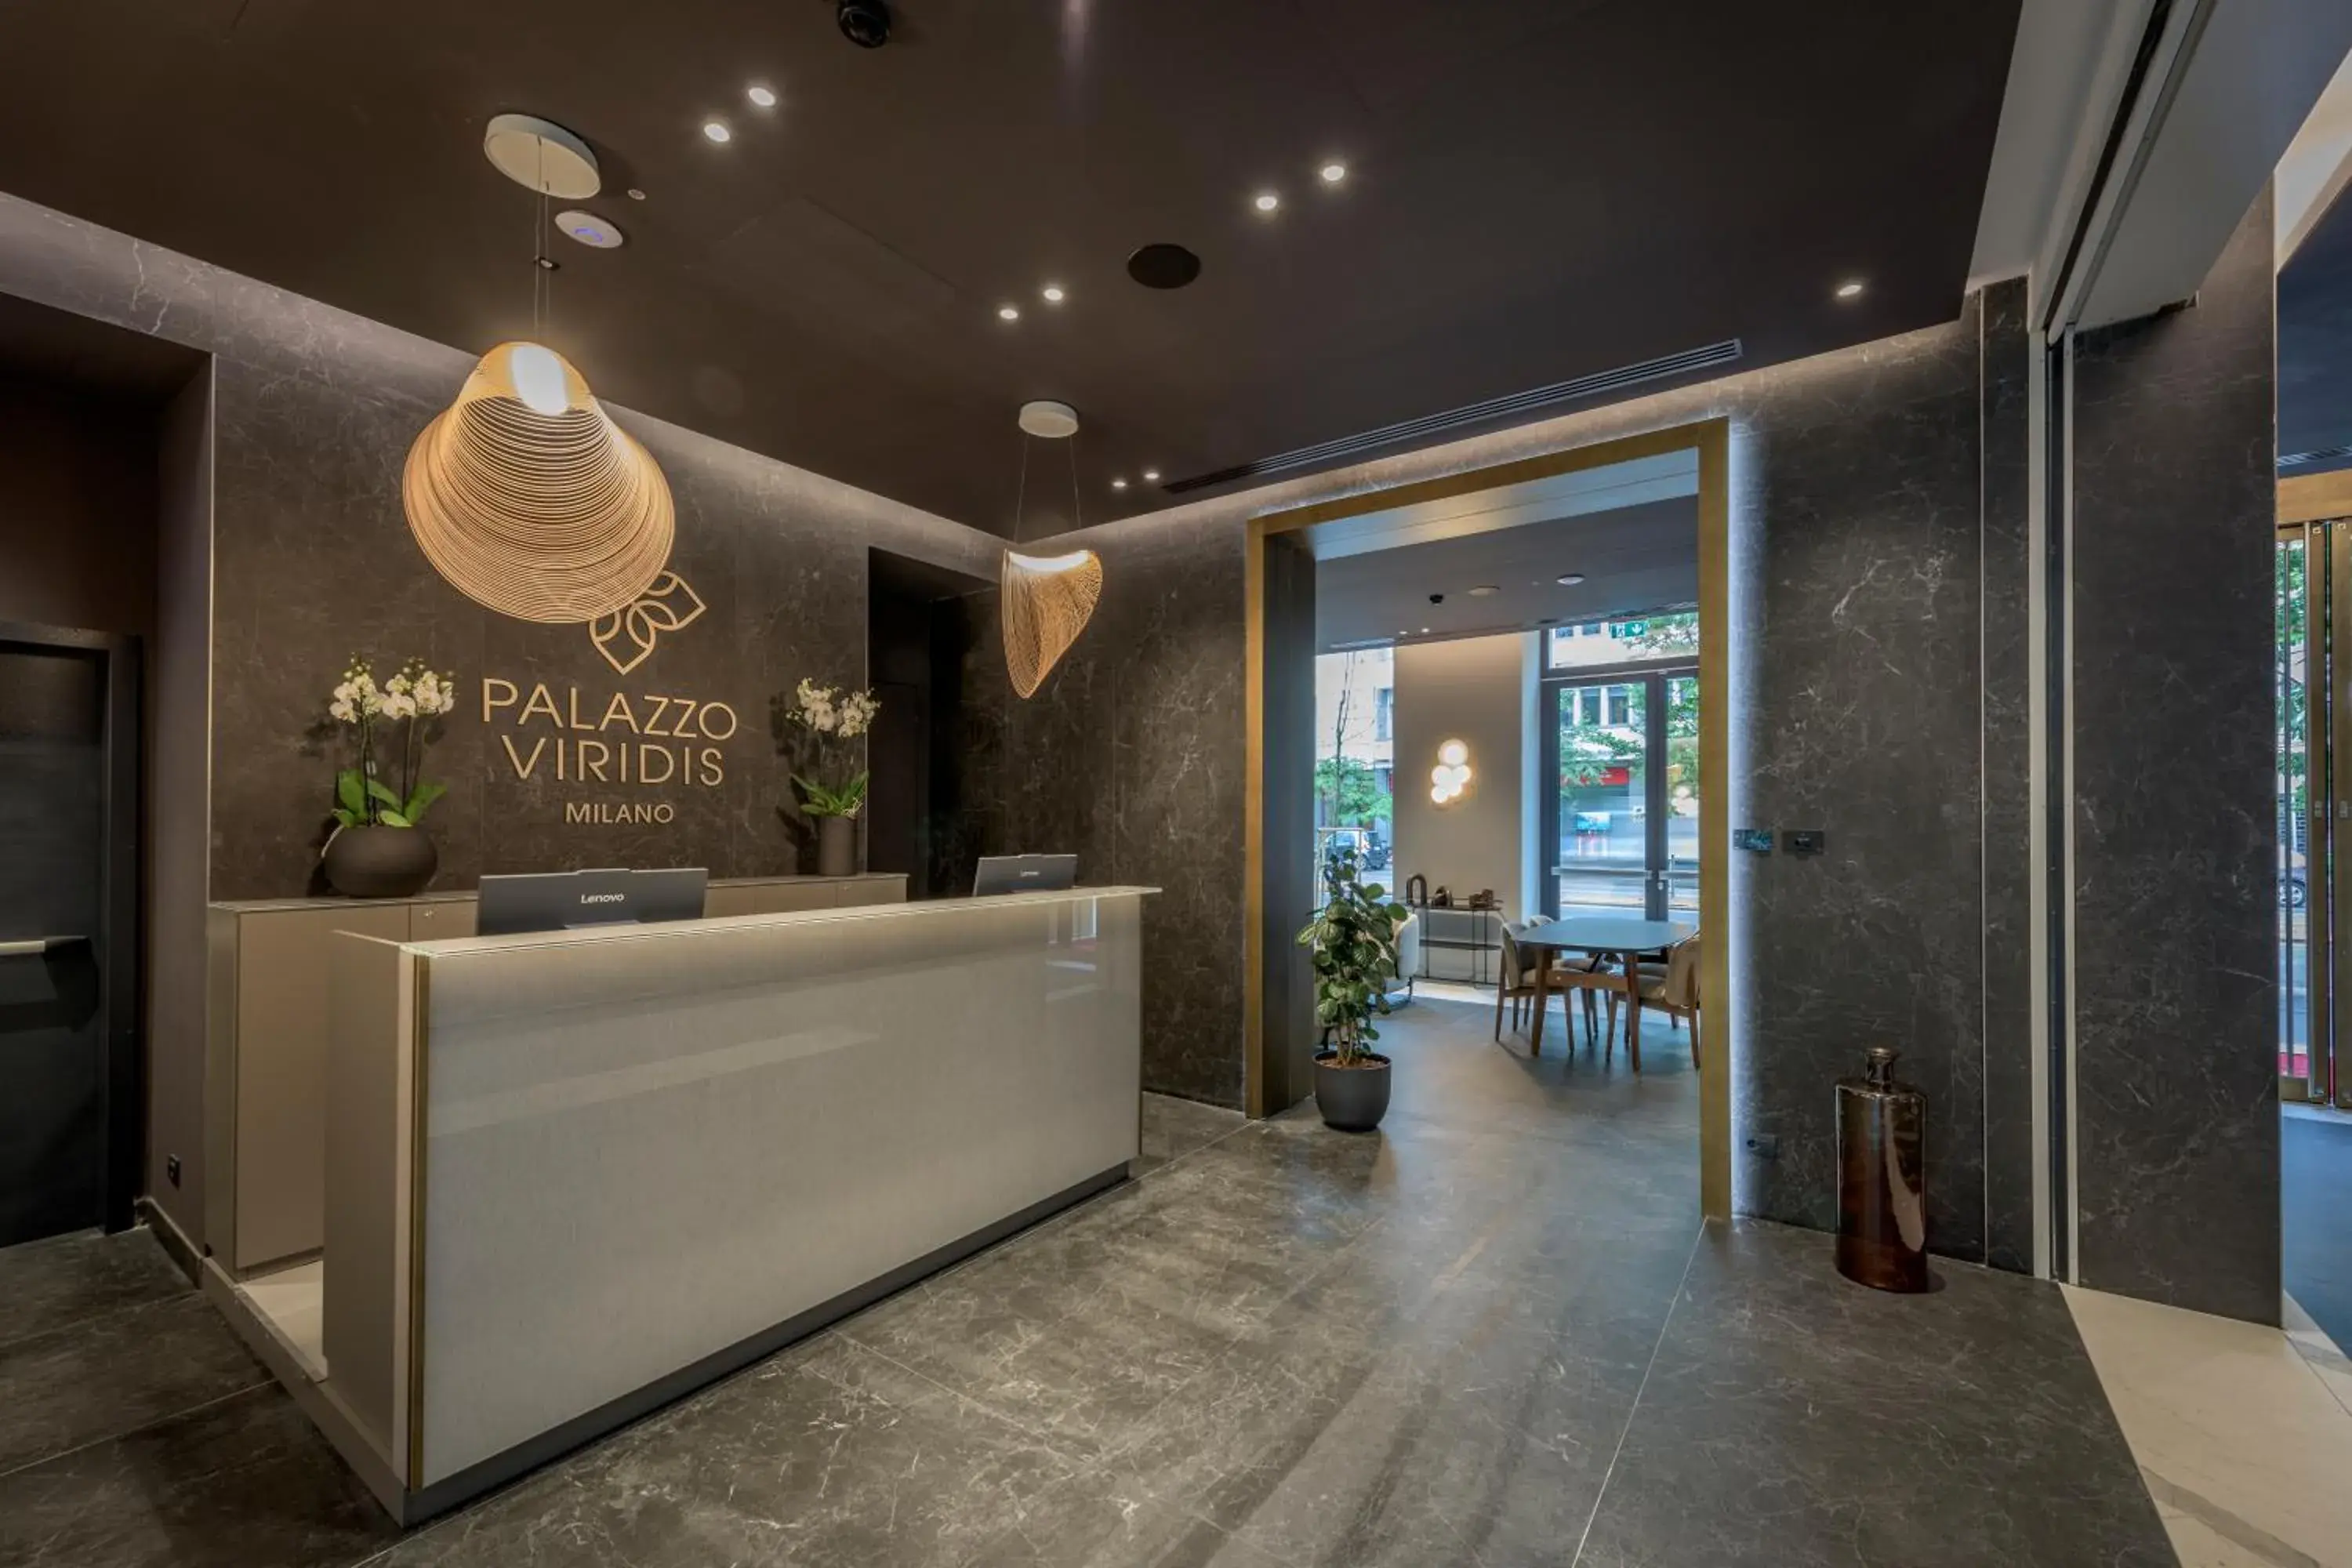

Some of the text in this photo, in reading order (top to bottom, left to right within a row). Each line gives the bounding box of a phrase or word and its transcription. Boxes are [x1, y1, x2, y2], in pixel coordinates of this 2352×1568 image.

[482, 678, 737, 740] PALAZZO
[502, 735, 724, 786] VIRIDIS
[565, 802, 674, 823] MILANO
[581, 893, 625, 904] Lenovo
